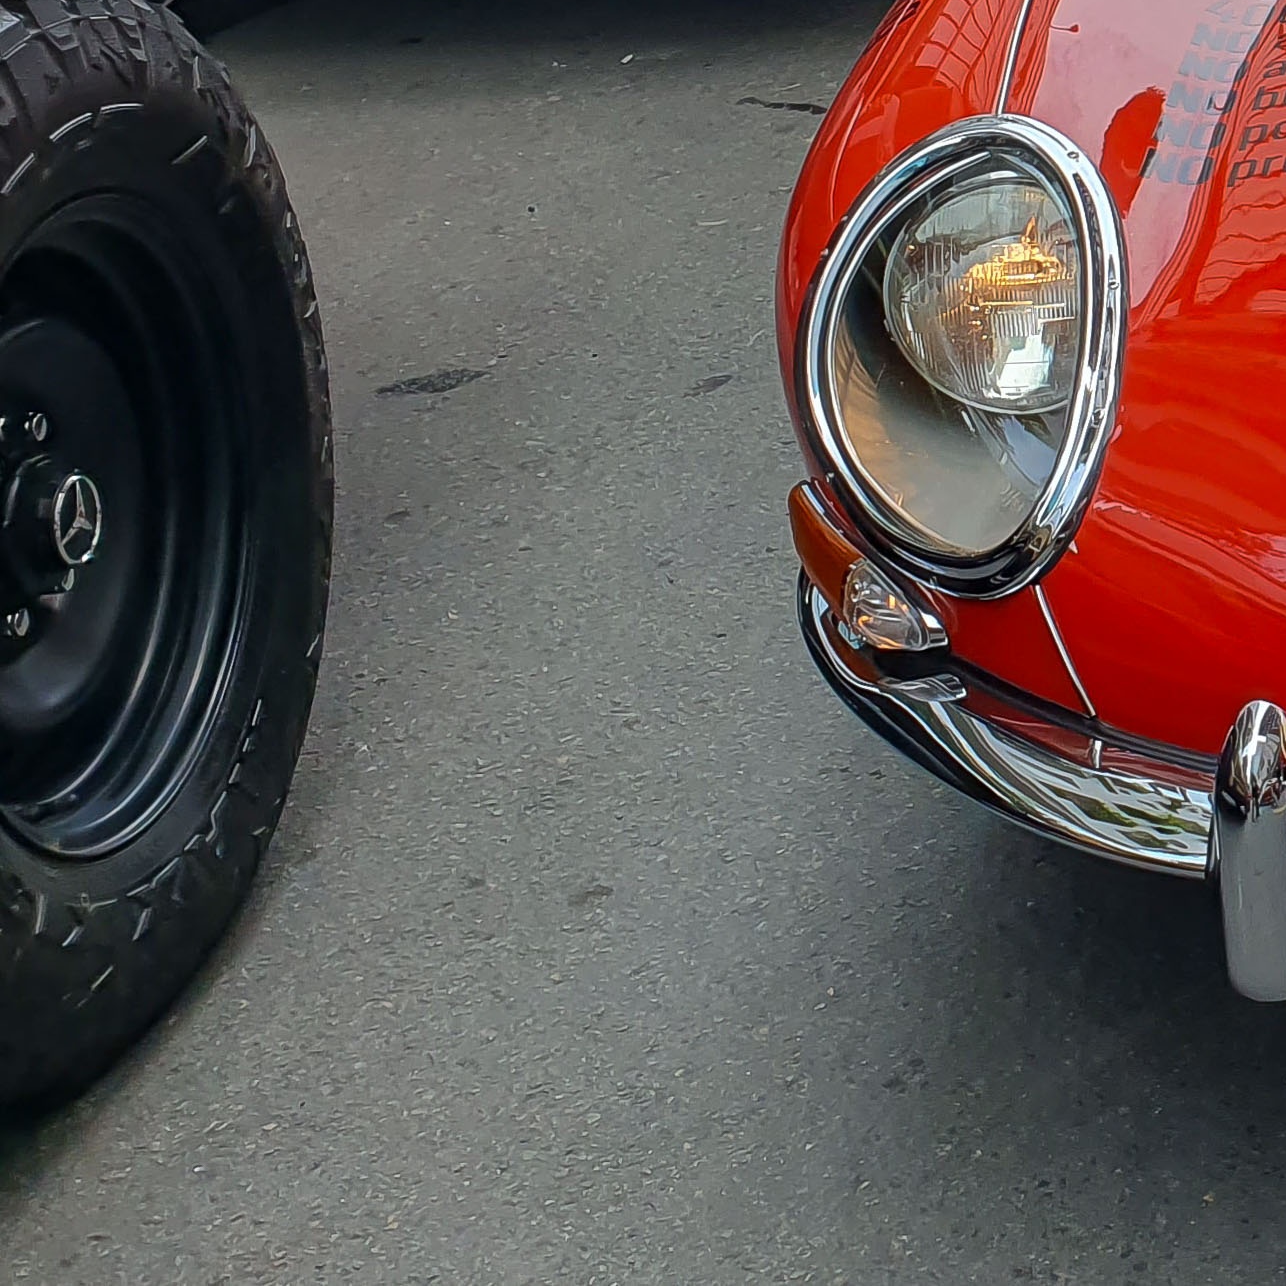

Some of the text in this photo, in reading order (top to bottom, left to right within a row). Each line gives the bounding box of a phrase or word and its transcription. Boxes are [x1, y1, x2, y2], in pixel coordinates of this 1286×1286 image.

[1190, 22, 1261, 54] NO
[1178, 50, 1249, 84] NO
[1166, 80, 1237, 115] NO
[1153, 113, 1228, 149] NO
[1140, 147, 1214, 186] NO
